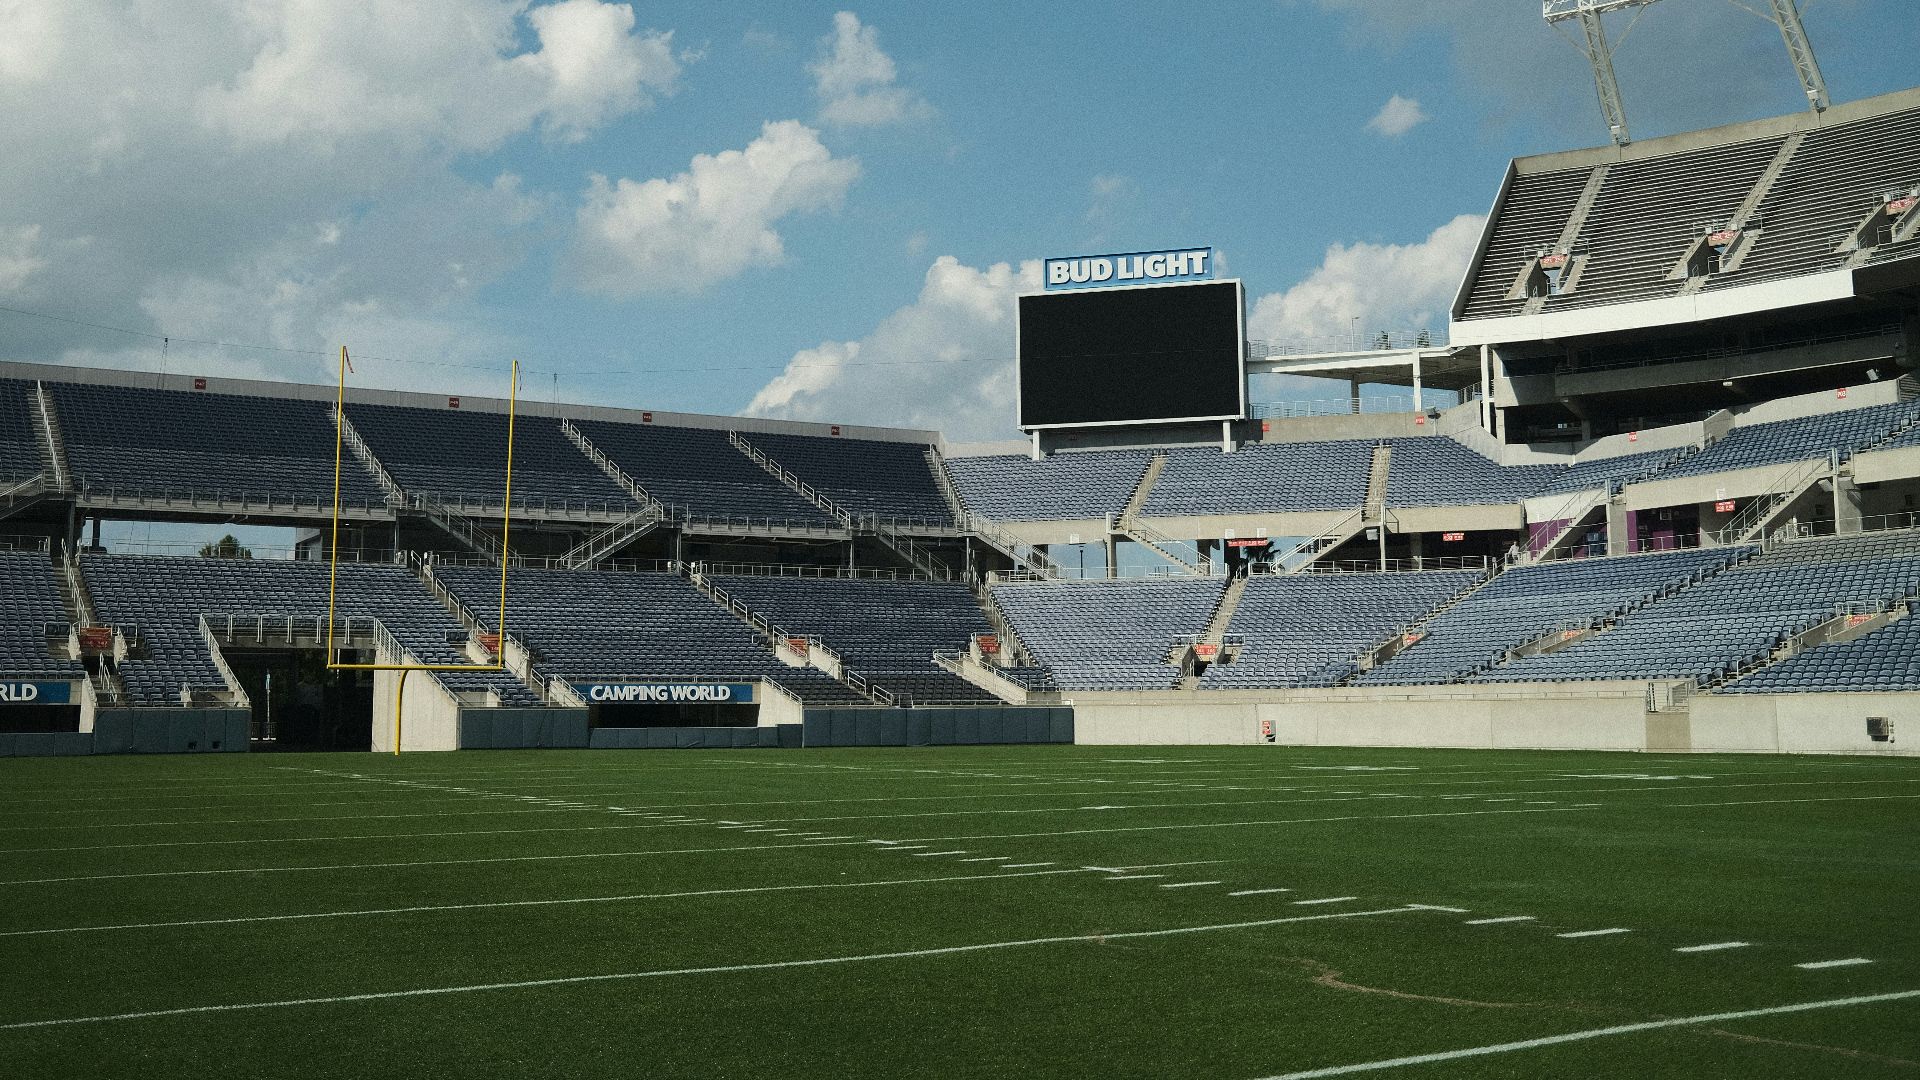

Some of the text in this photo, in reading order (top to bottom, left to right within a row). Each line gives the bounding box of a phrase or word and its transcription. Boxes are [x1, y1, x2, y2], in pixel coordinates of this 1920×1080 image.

[1050, 251, 1208, 285] BUD LIGHT
[0, 683, 38, 701] RLD
[590, 685, 731, 701] CAMPING WORLD
